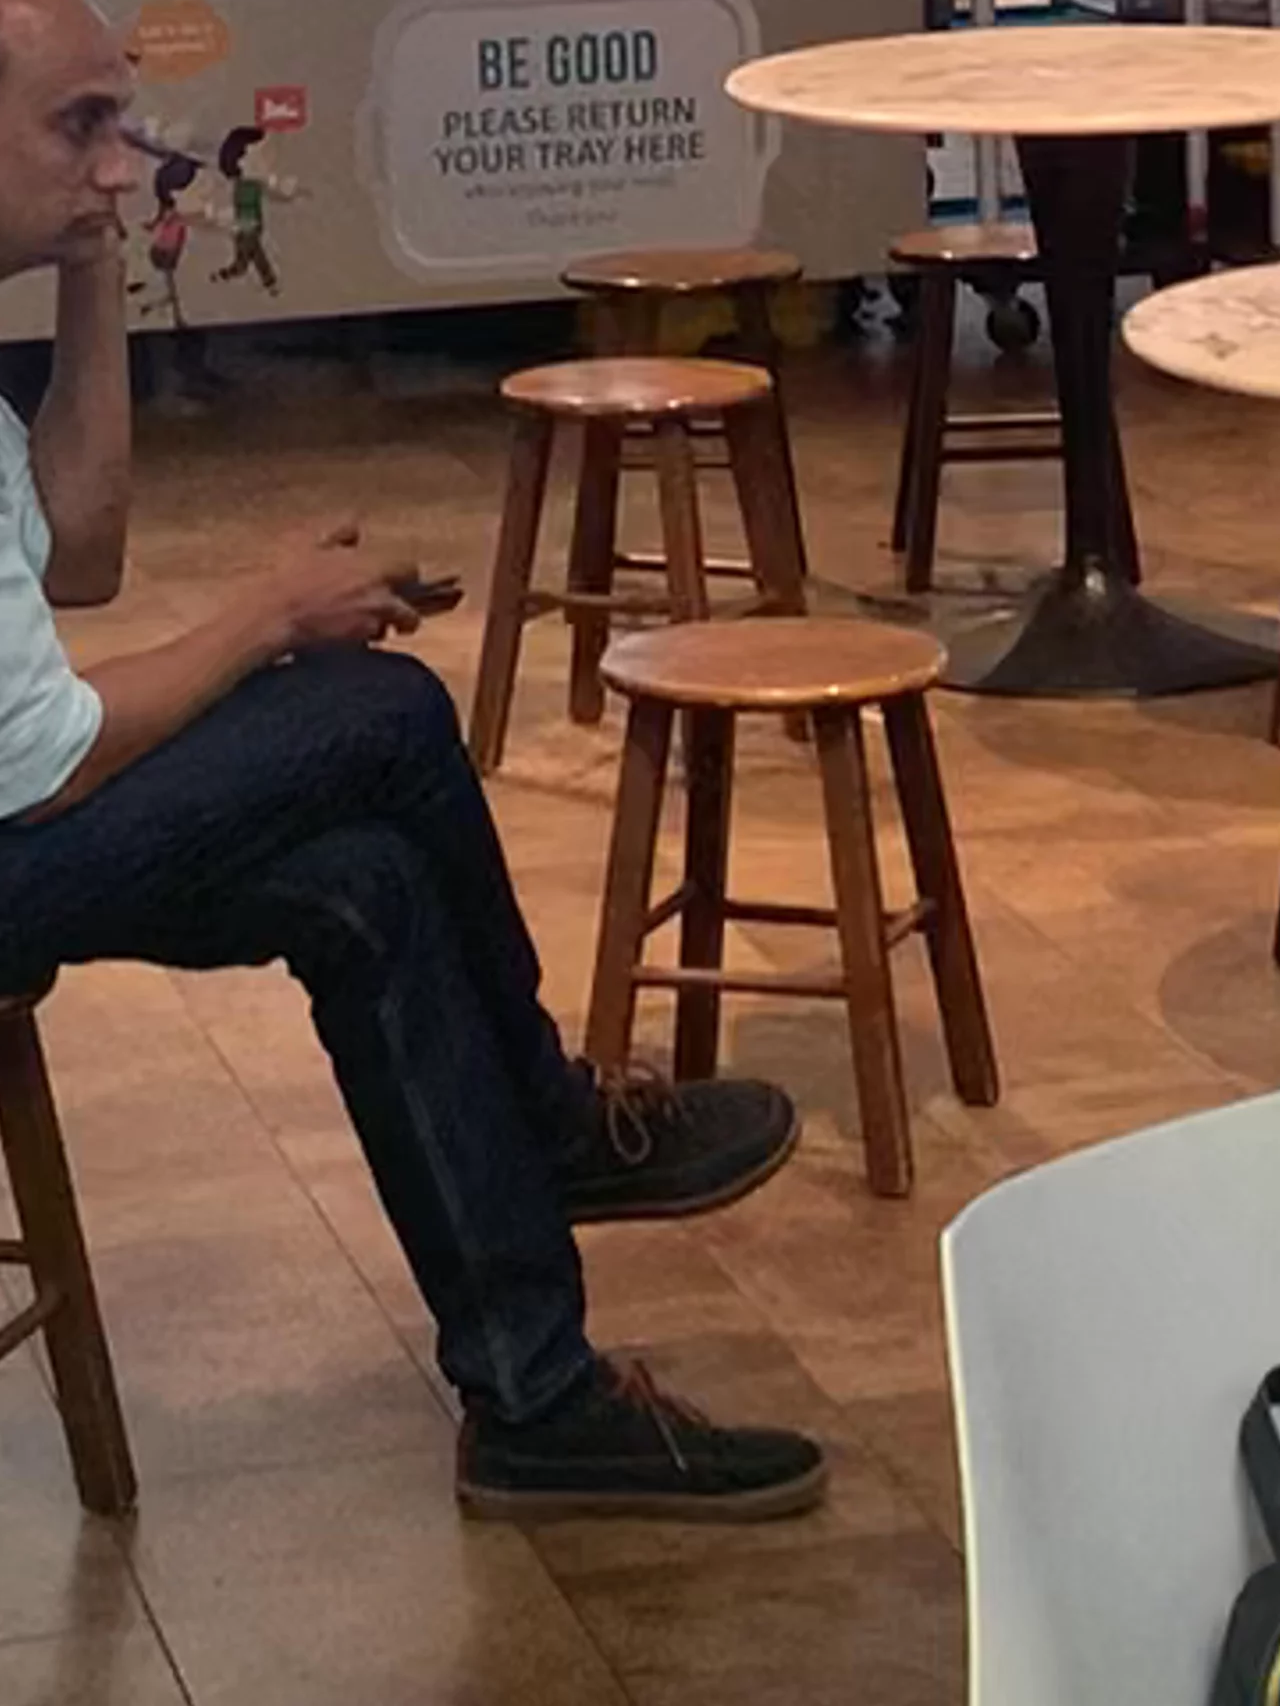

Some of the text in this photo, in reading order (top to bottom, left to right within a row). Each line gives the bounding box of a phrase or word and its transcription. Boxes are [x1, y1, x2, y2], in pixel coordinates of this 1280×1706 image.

[478, 29, 658, 91] BE GOOD
[442, 96, 697, 138] PLEASE RETURN
[432, 129, 707, 177] YOUR TRAY HERE
